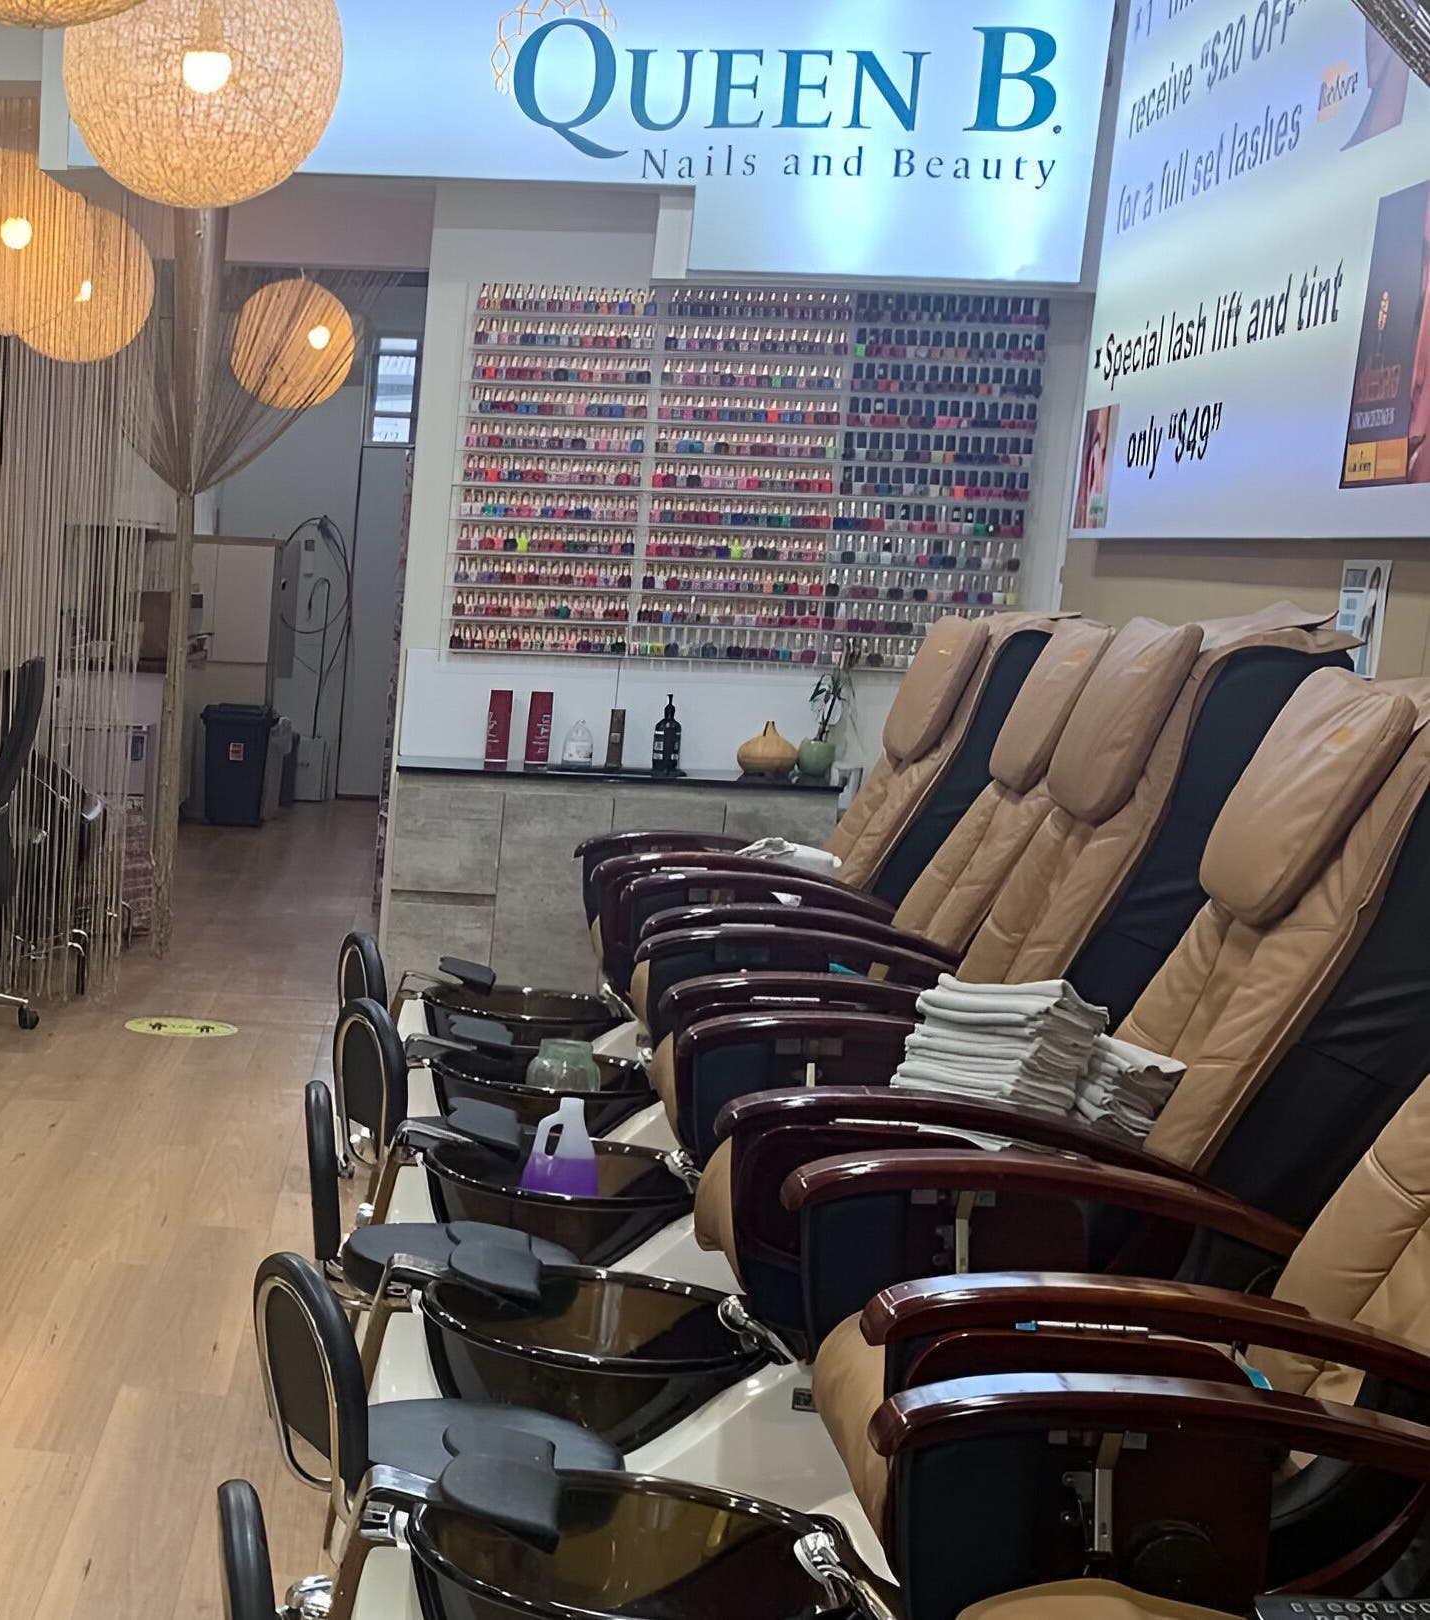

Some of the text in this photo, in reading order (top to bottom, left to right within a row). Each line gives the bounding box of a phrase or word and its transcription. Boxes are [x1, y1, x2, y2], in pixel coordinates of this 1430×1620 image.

[513, 17, 932, 159] QUEEN
[1128, 61, 1193, 140] receive
[640, 145, 1057, 190] Nails and Beauty
[1116, 103, 1301, 235] for a full set lashes
[1167, 301, 1207, 364] lash
[1211, 290, 1243, 353] lift
[1246, 272, 1293, 344] and
[1297, 257, 1344, 332] tint
[1127, 415, 1163, 480] only
